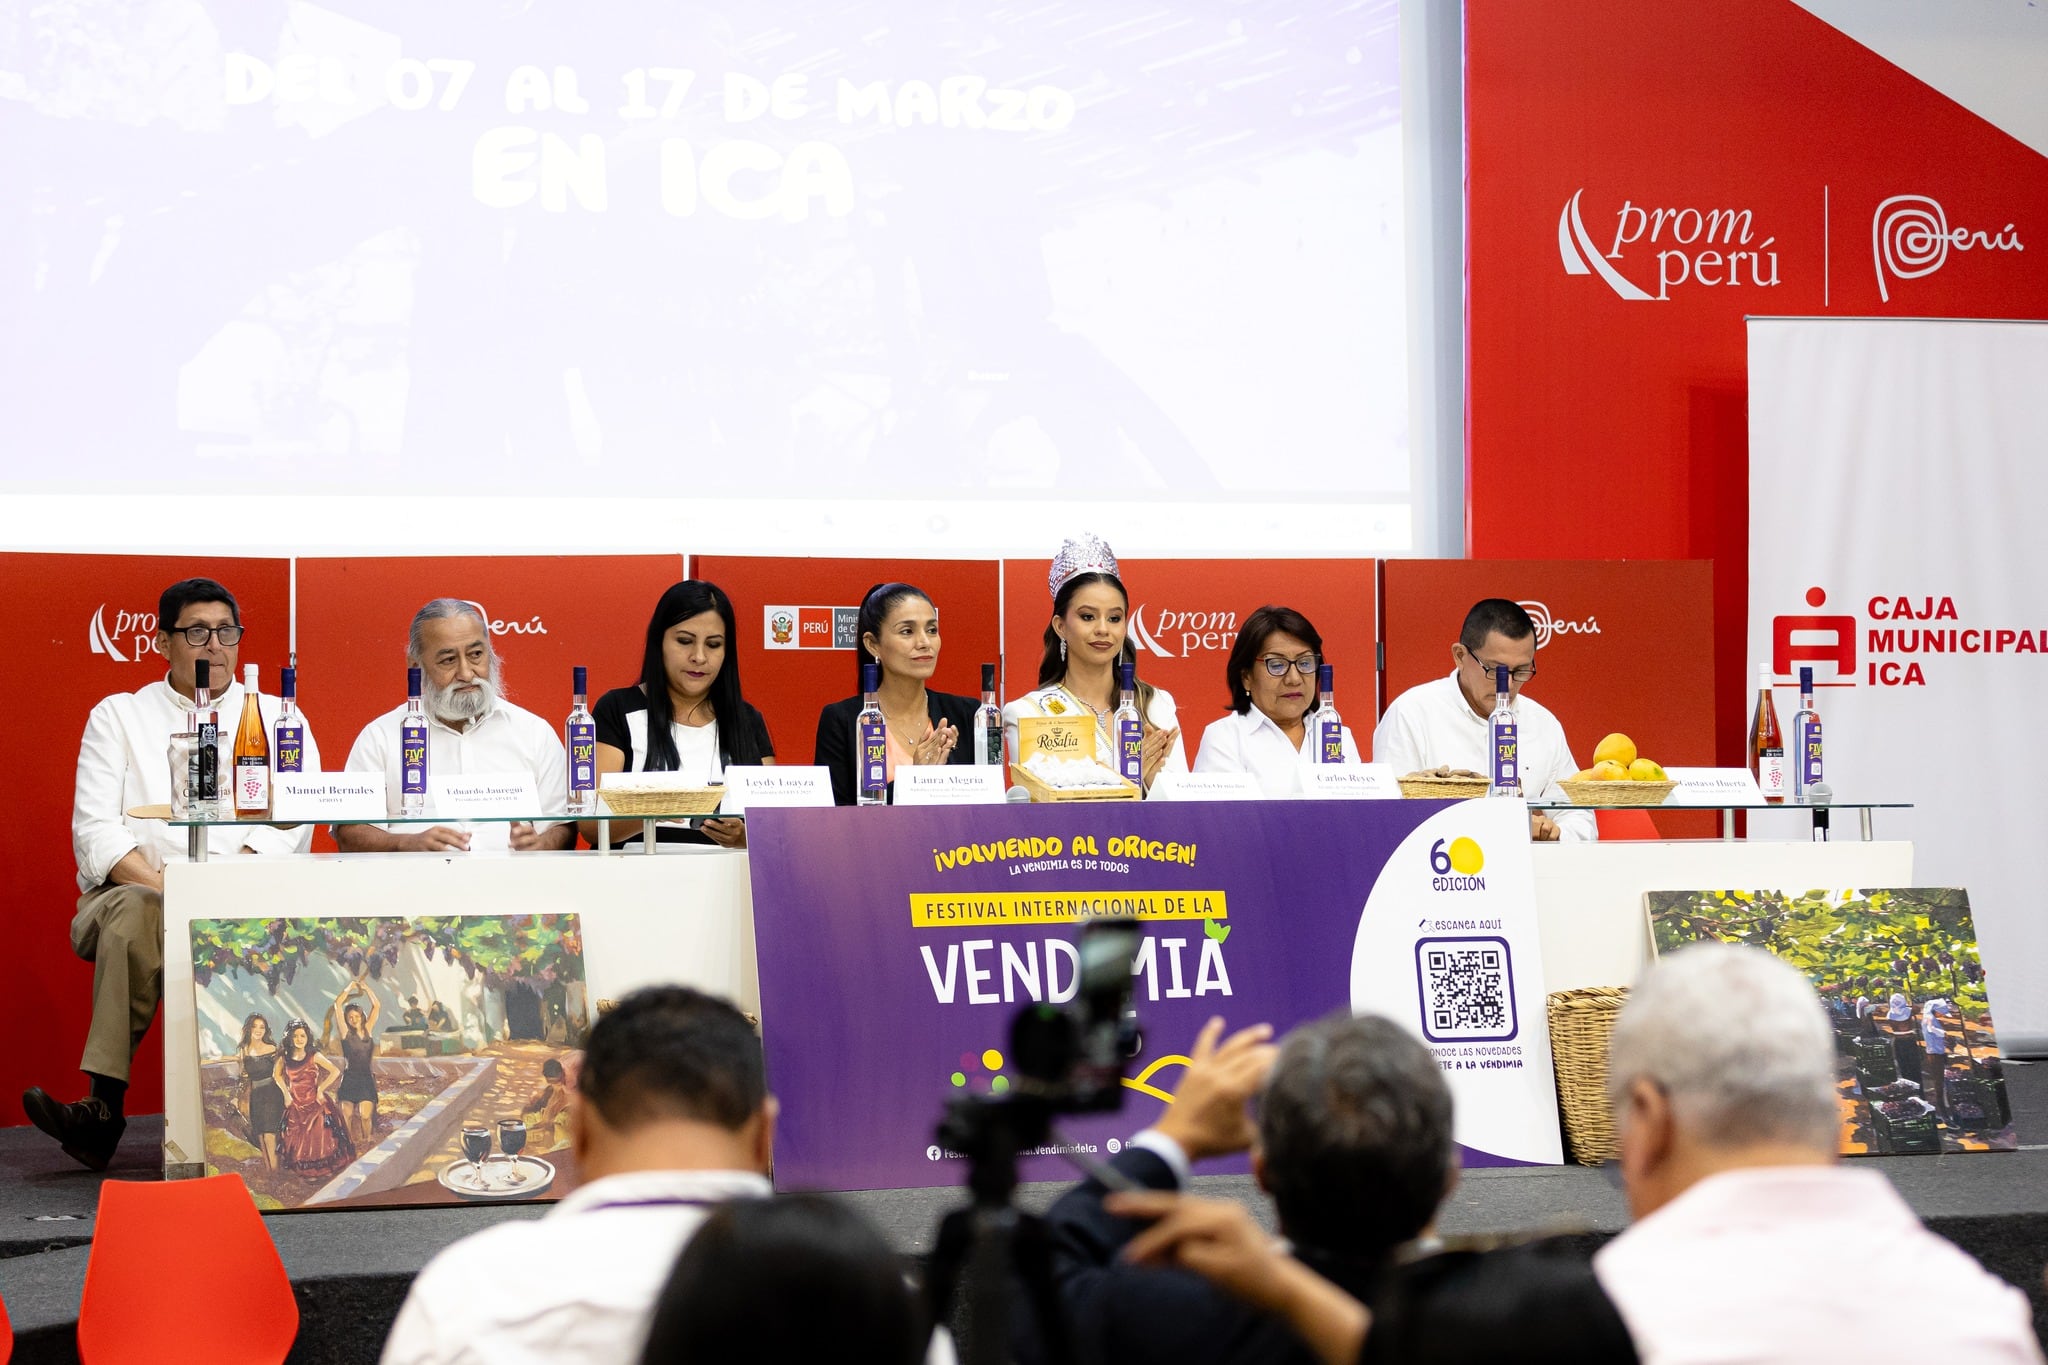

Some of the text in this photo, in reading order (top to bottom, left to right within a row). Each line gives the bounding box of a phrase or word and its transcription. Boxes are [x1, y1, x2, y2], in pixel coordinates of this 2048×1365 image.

[224, 52, 1076, 132] DEL 07 AL 17 DE MARZO
[471, 125, 855, 223] EN ICA
[1605, 200, 1755, 259] prom
[1872, 194, 2024, 302] Perú
[1655, 236, 1781, 301] perú
[463, 600, 548, 635] erú
[1867, 596, 1959, 620] CAJA
[111, 609, 160, 640] pro
[803, 620, 829, 634] PERÚ
[838, 624, 848, 633] de
[1153, 608, 1237, 637] prom
[837, 635, 843, 645] y
[1181, 631, 1239, 657] per
[1868, 629, 2048, 653] MUNICIPAL
[1868, 662, 1926, 686] ICA
[285, 786, 375, 795] Manuel Bernales
[446, 787, 484, 795] Eduardo
[745, 778, 814, 788] Leydy Loayza
[913, 776, 944, 784] Laura
[1317, 774, 1376, 784] Carlos Reyes
[1679, 779, 1746, 787] Gustavo Huerta
[932, 835, 1197, 873] ¡VOLVIENDO AL ORIGEN!
[1009, 865, 1021, 875] LA
[1100, 860, 1129, 874] TODOS
[926, 897, 1214, 920] FESTIVAL INTERNACIONAL DE LA
[920, 936, 1233, 1005] VENDMIA
[1427, 1047, 1457, 1057] ONOCE
[1459, 1047, 1473, 1057] LAS
[1456, 1061, 1462, 1070] A
[1465, 1060, 1476, 1069] LA
[1480, 1059, 1523, 1069] VENDIMIA
